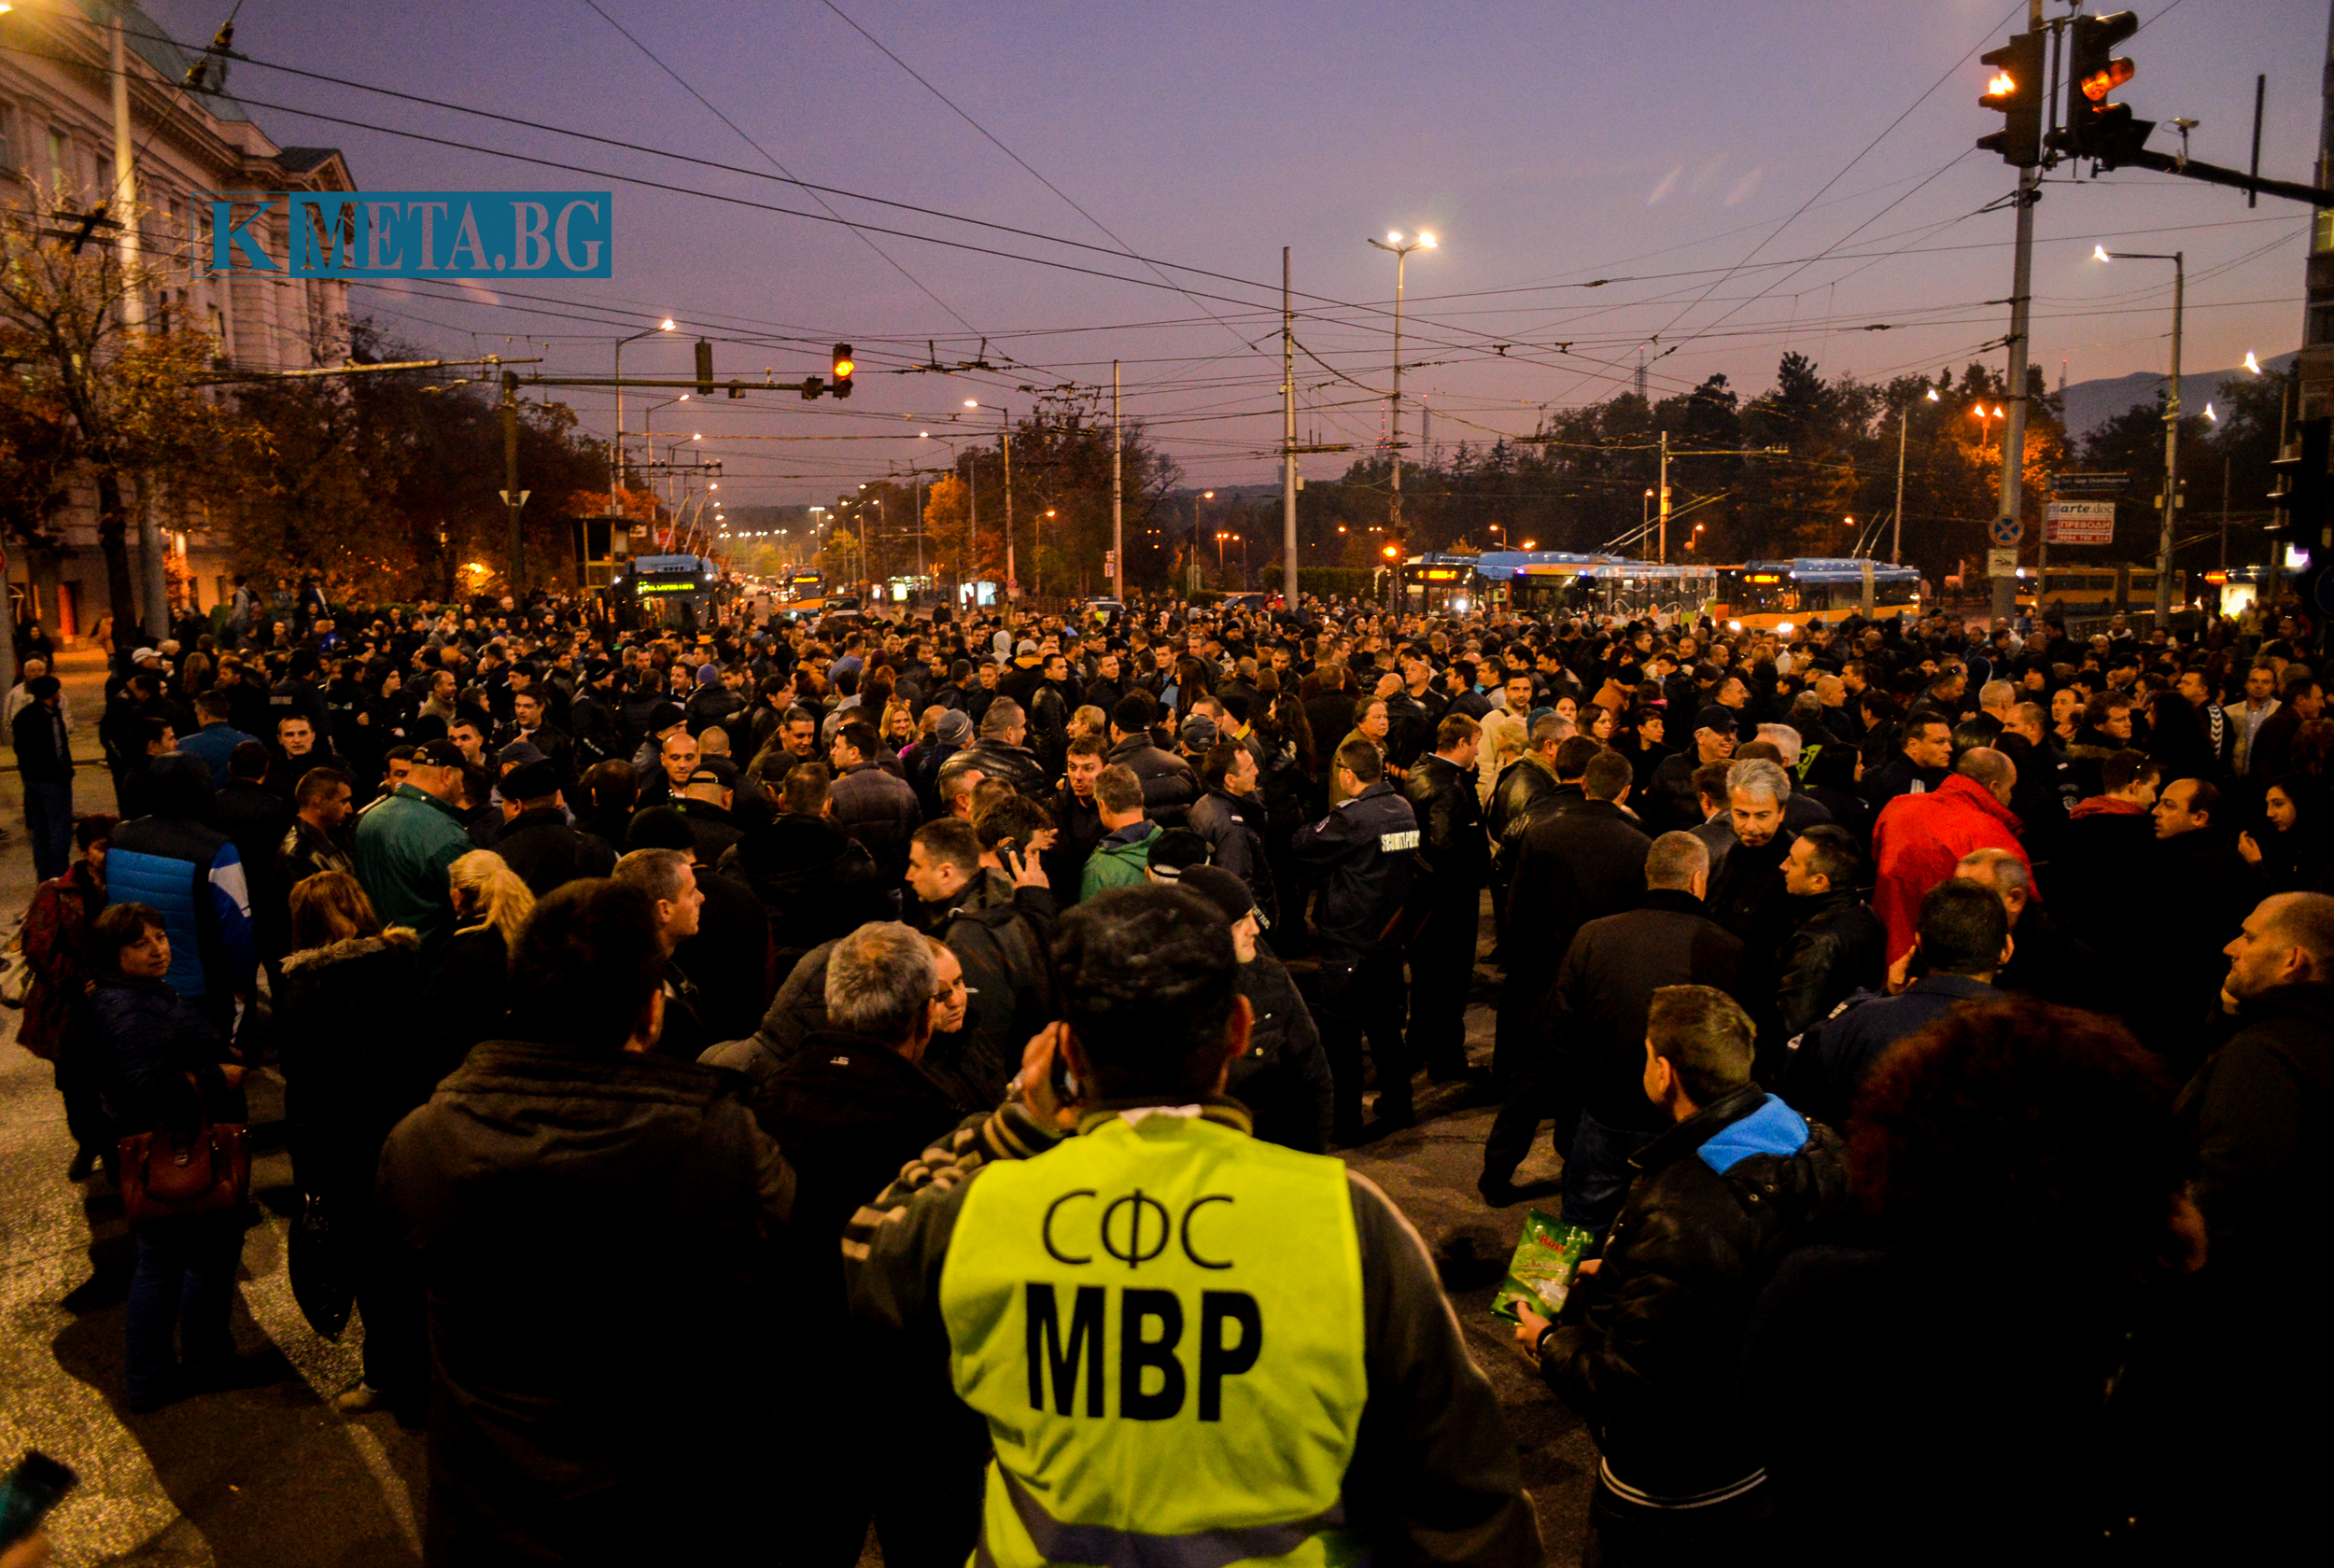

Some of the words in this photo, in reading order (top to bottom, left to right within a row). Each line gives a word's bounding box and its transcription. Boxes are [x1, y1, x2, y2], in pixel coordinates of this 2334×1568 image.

[2060, 521, 2110, 529] ПРЕВОДИ
[1042, 1187, 1235, 1269] СФС
[1025, 1281, 1263, 1422] МВР
